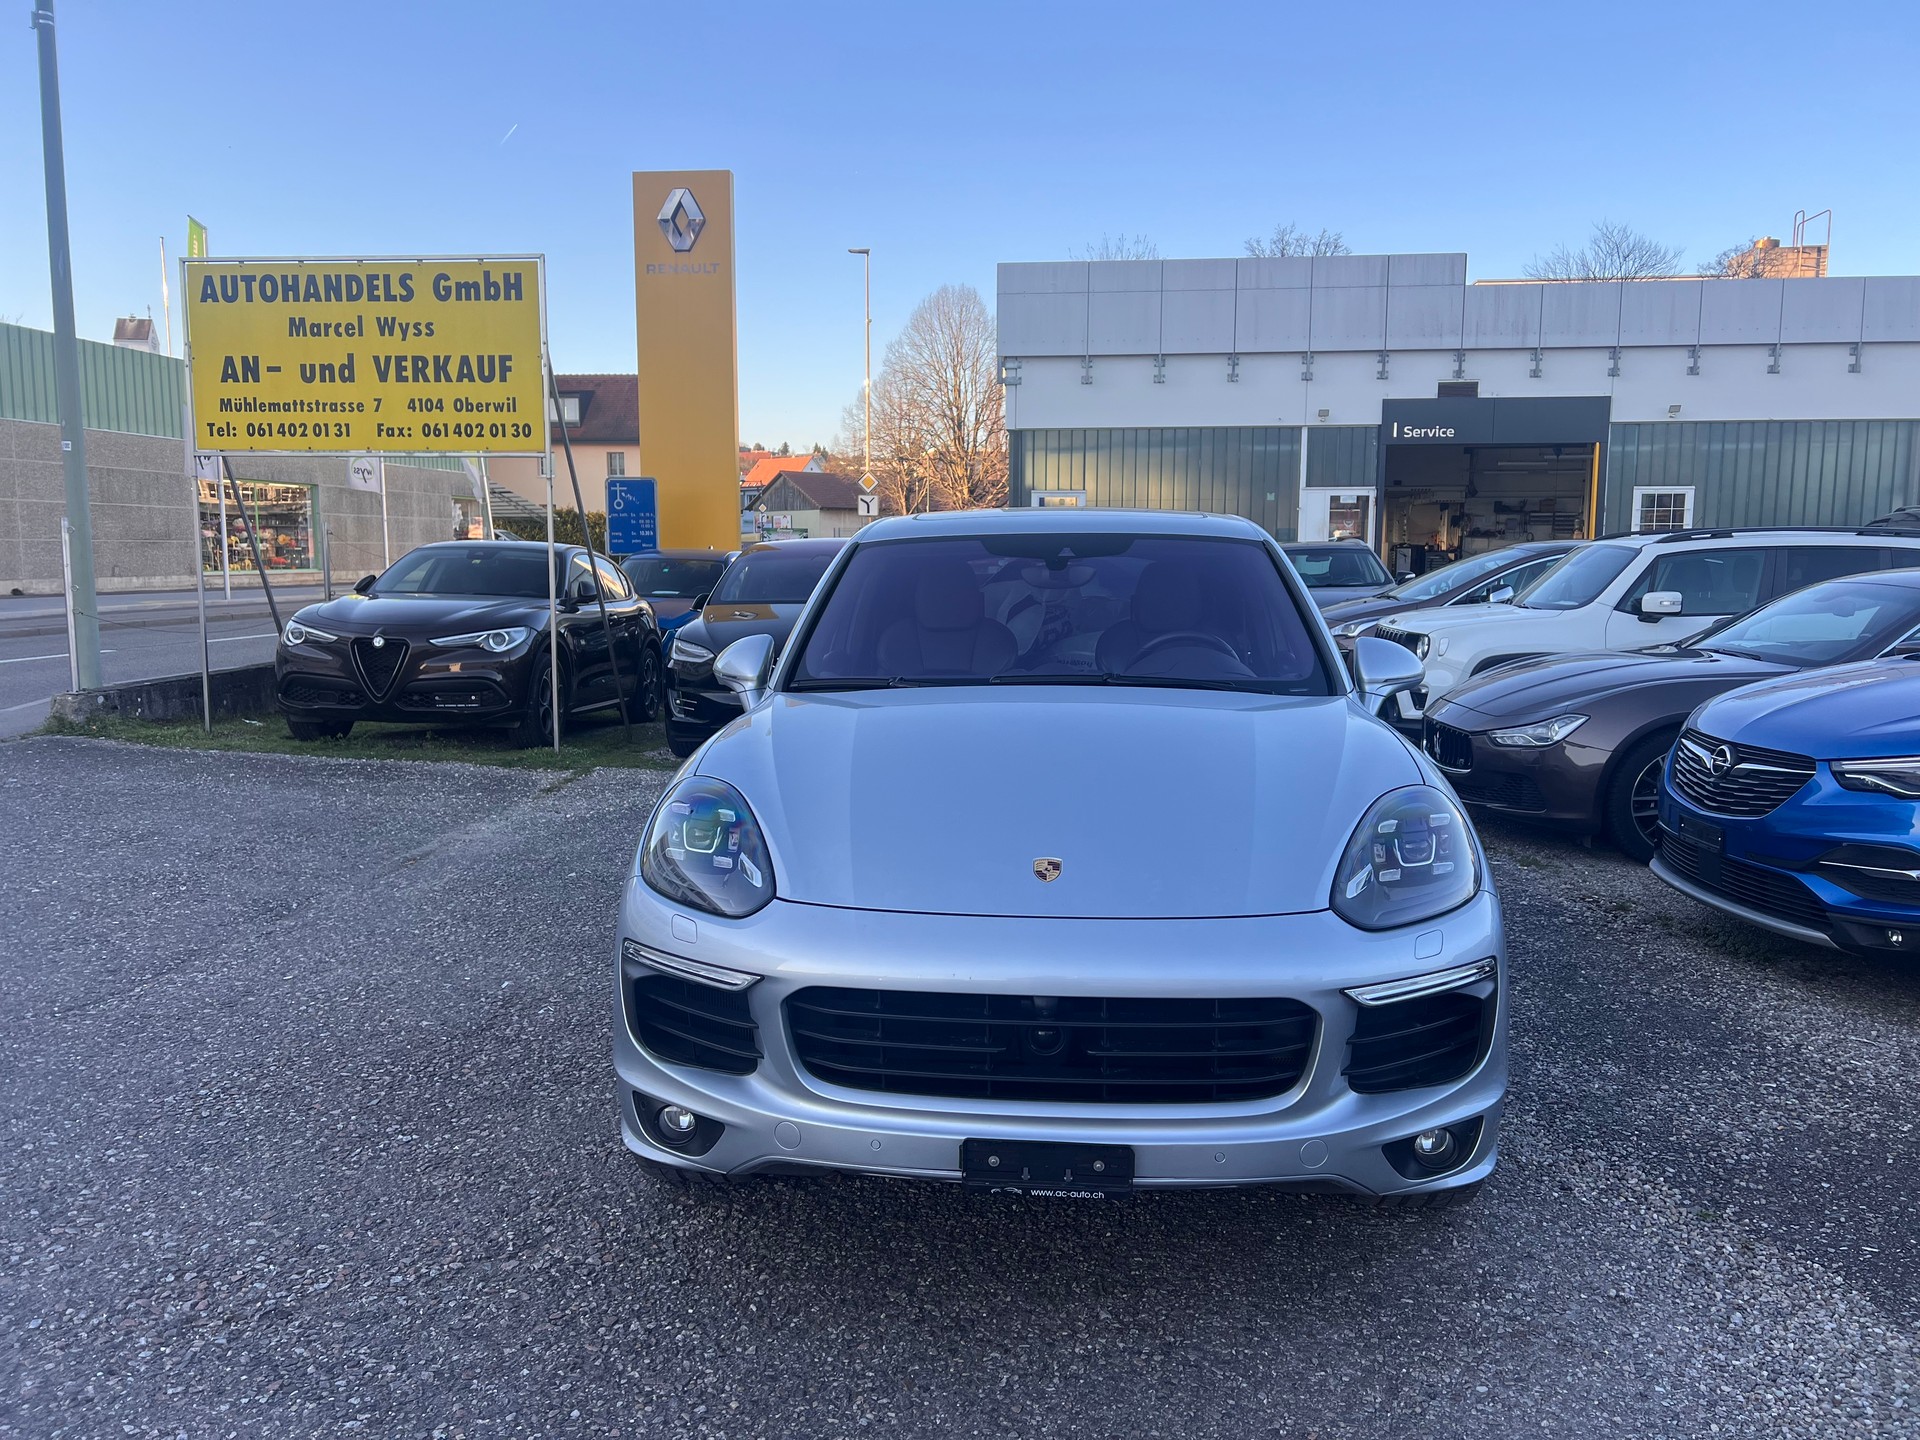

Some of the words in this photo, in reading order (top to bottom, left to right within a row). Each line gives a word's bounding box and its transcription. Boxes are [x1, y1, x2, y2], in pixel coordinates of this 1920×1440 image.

[646, 263, 720, 275] RENAULT
[200, 272, 414, 303] AUTOHANDELS
[433, 270, 523, 302] GmbH
[289, 315, 363, 337] Marcel
[376, 316, 435, 341] Wyss
[300, 353, 355, 383] und
[372, 354, 513, 383] VERKAUF
[219, 397, 365, 412] Mühlemattstrasse
[373, 398, 382, 412] 7
[407, 397, 444, 412] 4104
[453, 396, 517, 412] Oberwil
[207, 421, 237, 437] Tel:
[377, 422, 412, 437] Fax:
[1403, 425, 1455, 438] Service
[1030, 1188, 1105, 1199] www.ac-auto.ch
